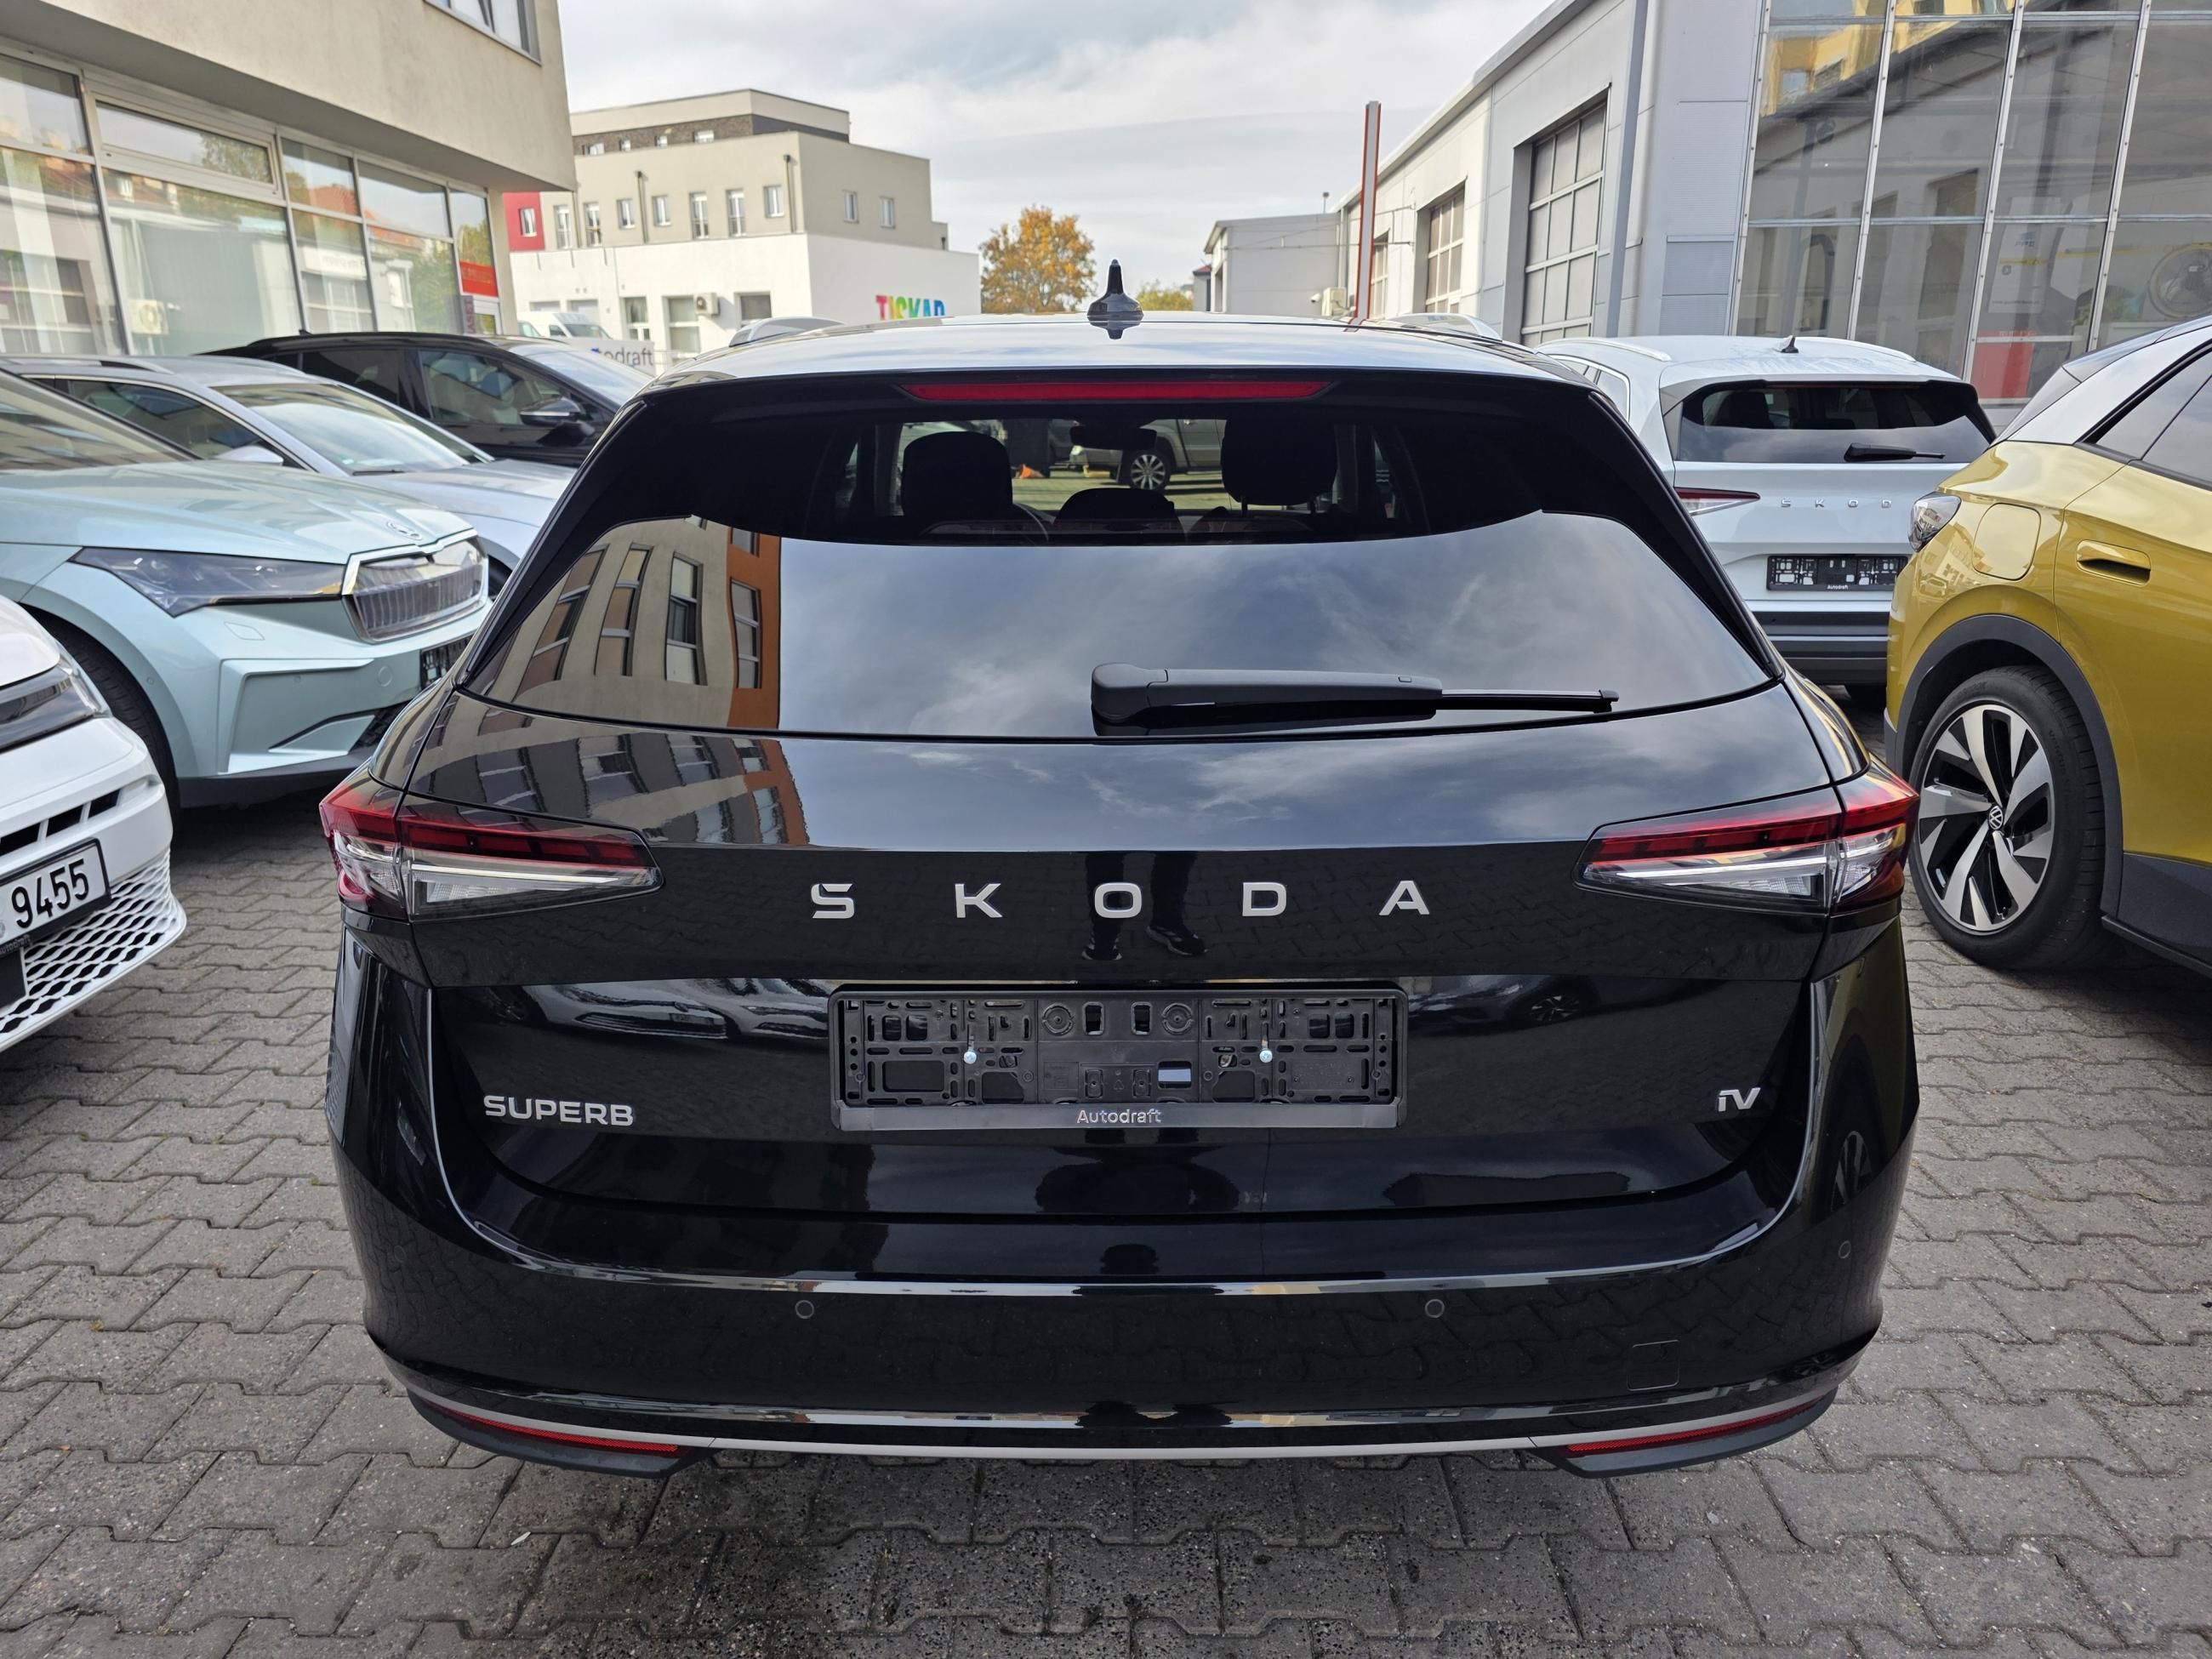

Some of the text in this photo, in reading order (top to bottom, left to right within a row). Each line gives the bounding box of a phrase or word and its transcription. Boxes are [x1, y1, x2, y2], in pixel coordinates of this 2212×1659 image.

[11, 858, 89, 928] 9455
[811, 880, 1431, 919] SKODA
[483, 1095, 634, 1126] SUPERB
[1076, 1108, 1162, 1124] Autodraft
